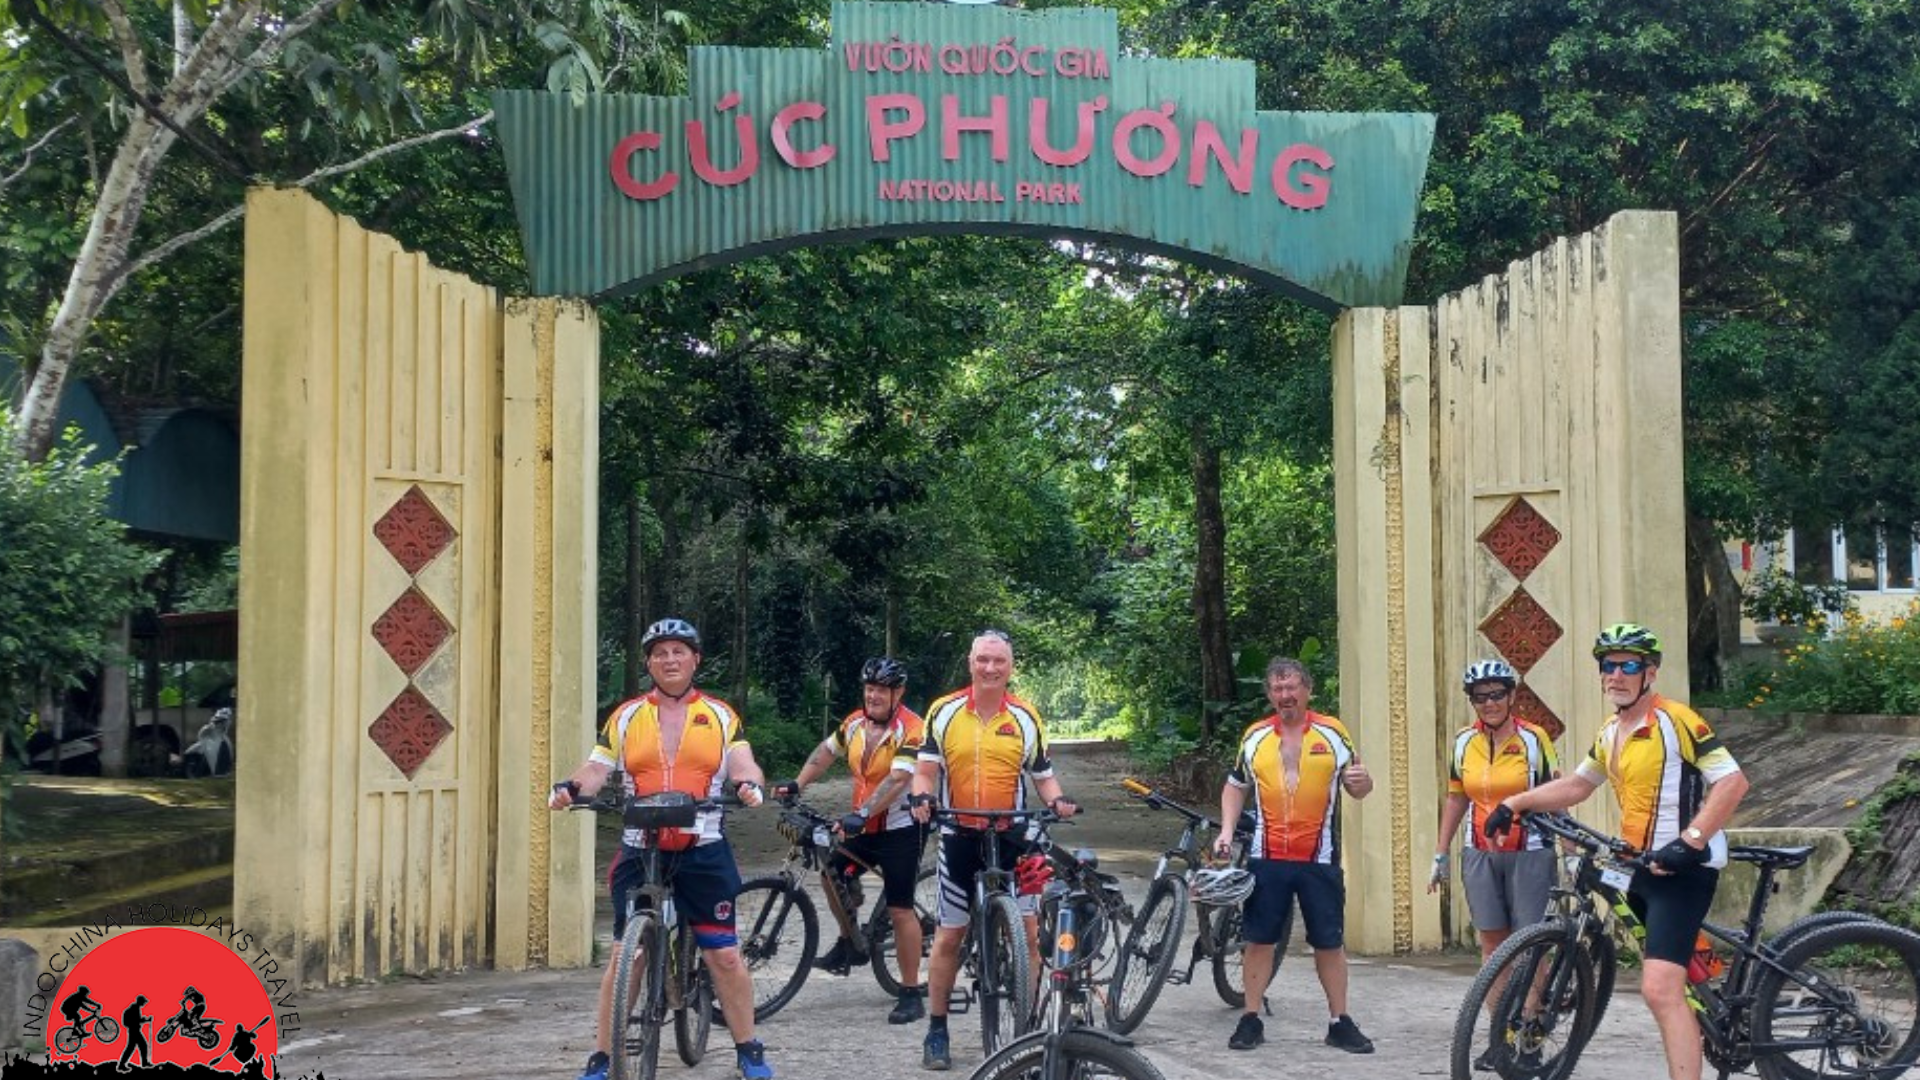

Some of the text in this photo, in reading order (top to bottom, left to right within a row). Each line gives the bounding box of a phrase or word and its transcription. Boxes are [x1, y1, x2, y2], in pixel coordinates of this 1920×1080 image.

[938, 36, 1047, 77] QUỐC
[1054, 46, 1110, 79] GIA
[609, 92, 1335, 210] CÚC PHƯƠNG
[879, 179, 1084, 205] NATIONAL PARK
